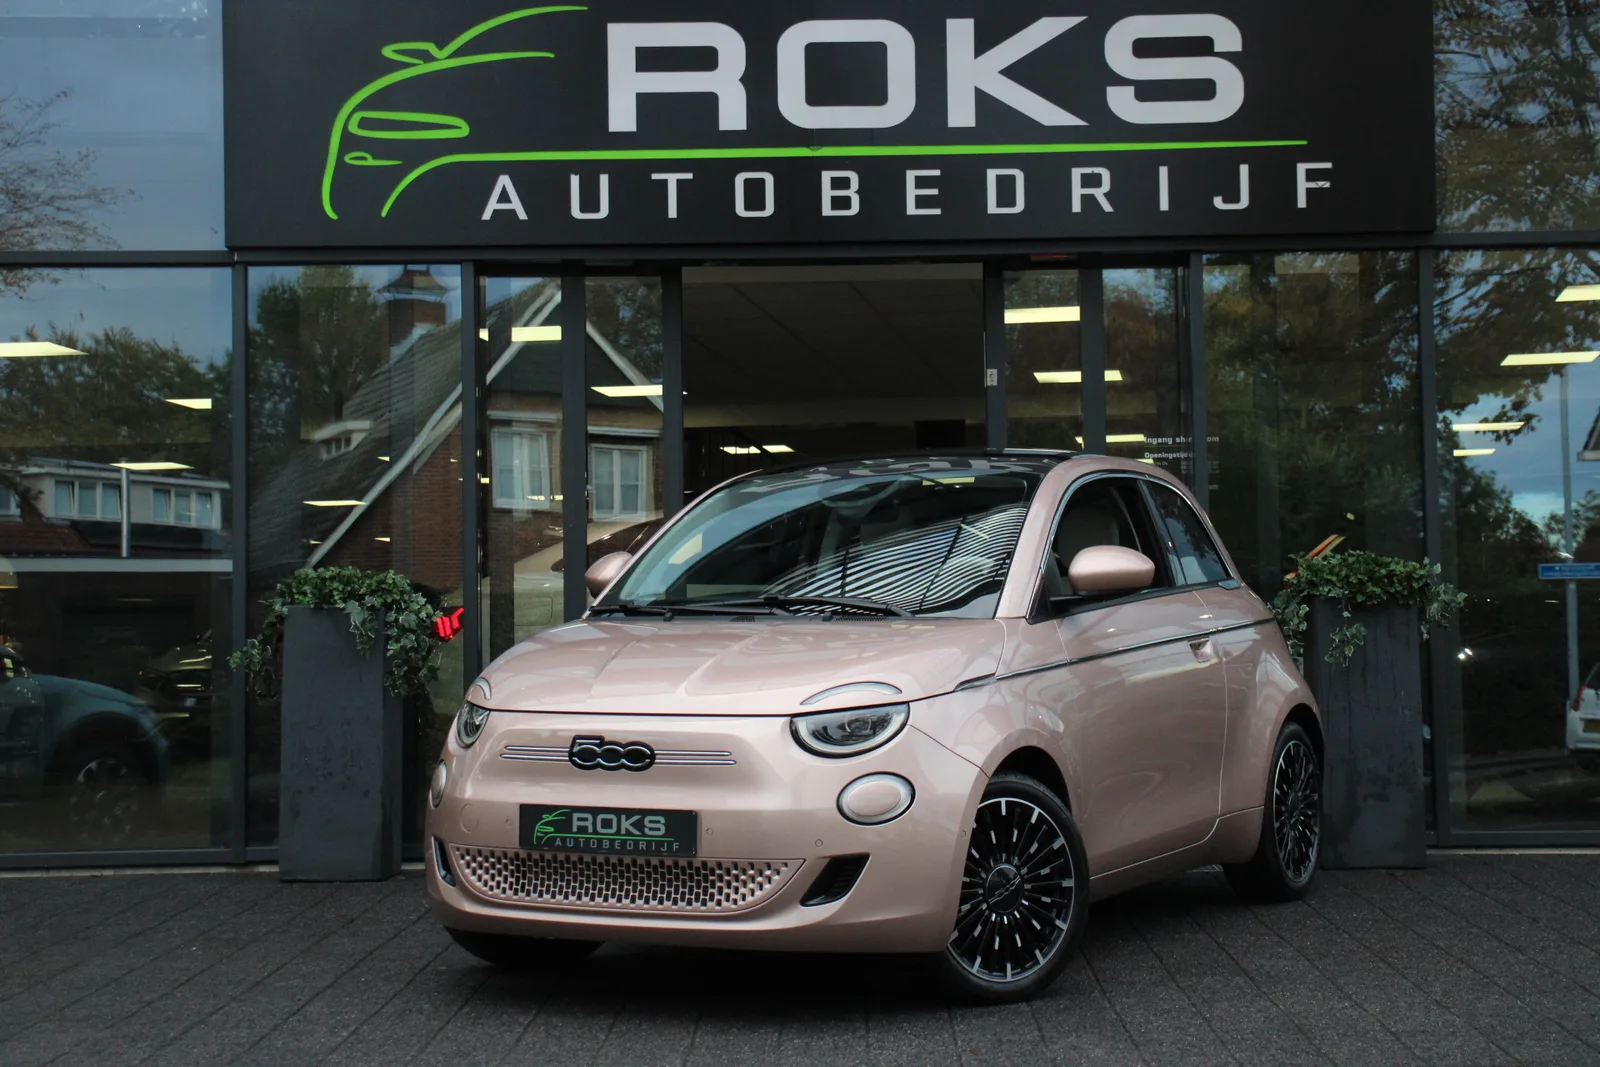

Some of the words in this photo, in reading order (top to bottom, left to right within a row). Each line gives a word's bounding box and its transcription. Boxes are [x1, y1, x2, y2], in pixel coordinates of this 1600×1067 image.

[607, 13, 1245, 133] ROKS
[481, 161, 1333, 220] AUTOBEDRIJF
[569, 735, 656, 772] 500
[572, 812, 666, 836] ROKS
[554, 837, 680, 851] AUTOBEDRIJF
